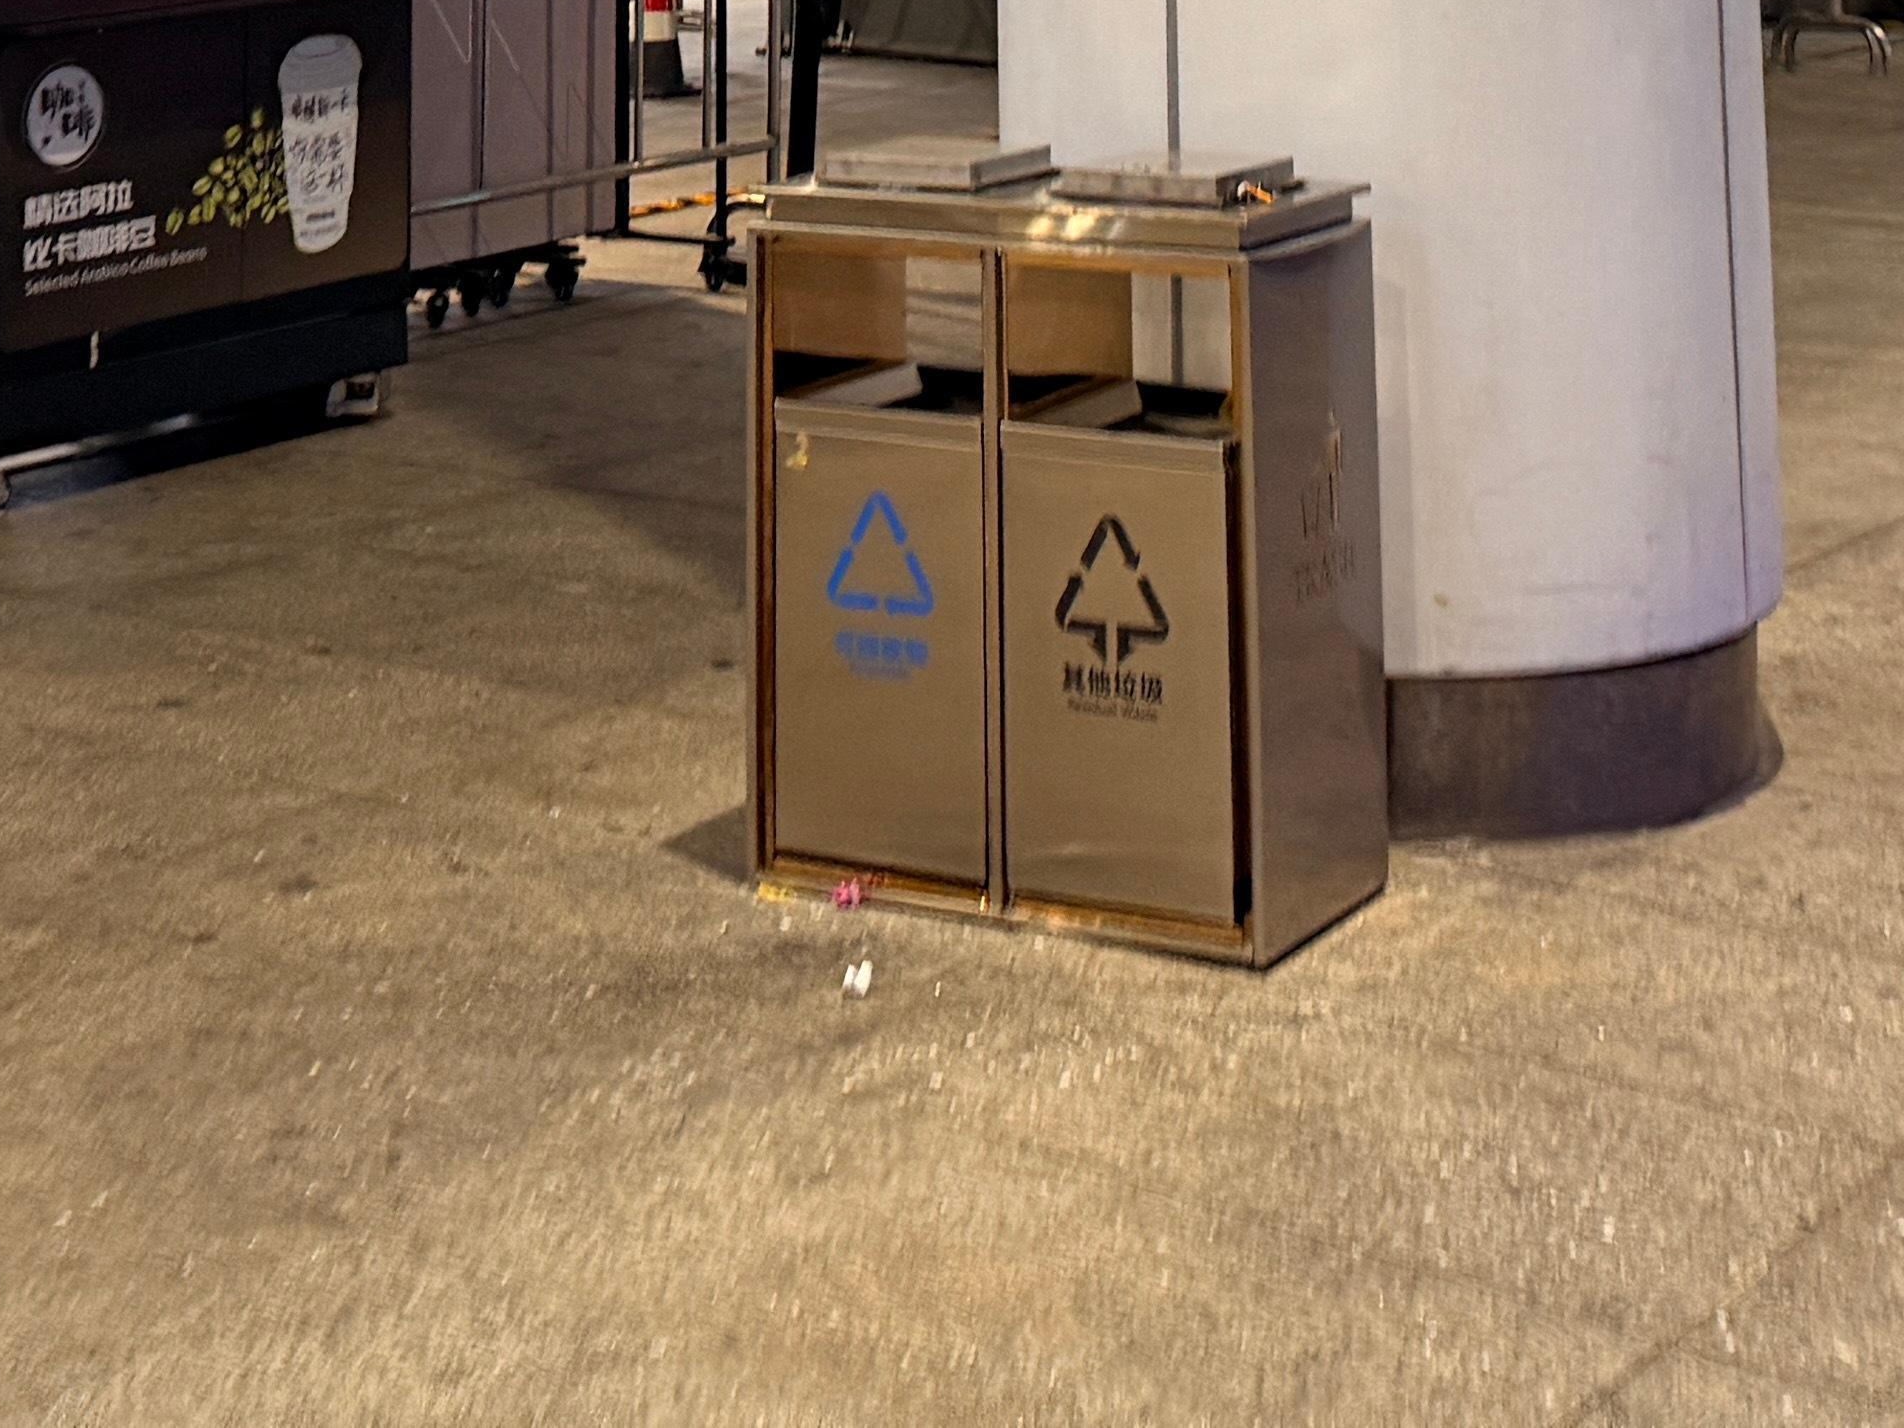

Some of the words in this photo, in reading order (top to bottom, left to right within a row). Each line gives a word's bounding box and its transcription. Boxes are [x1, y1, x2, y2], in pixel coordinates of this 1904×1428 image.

[23, 215, 157, 272] 比卡咖啡豆
[25, 268, 80, 297] Selected
[129, 254, 169, 275] Coffee
[169, 246, 208, 267] Beans
[1063, 661, 1163, 705] 其他垃圾
